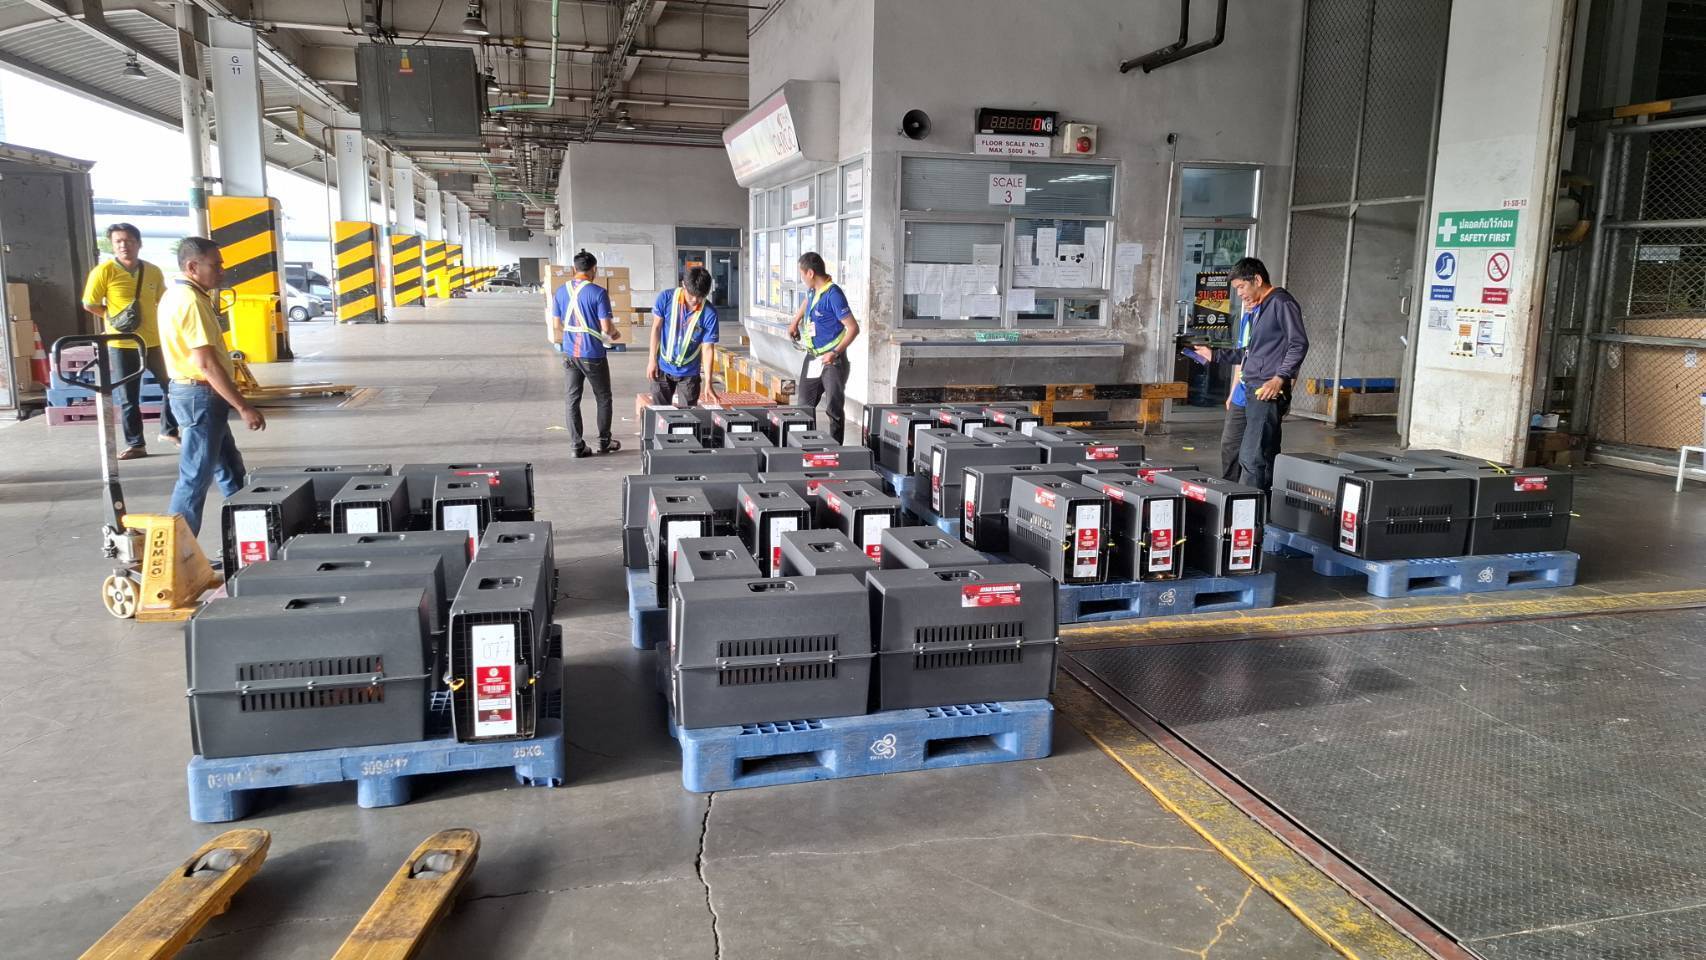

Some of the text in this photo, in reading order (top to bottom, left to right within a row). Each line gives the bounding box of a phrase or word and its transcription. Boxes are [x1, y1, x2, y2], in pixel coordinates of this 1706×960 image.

[231, 55, 240, 64] G
[232, 67, 241, 75] 11
[992, 176, 1024, 188] SCALE
[1004, 190, 1013, 204] 3
[1459, 233, 1511, 242] SAFETY FIRST
